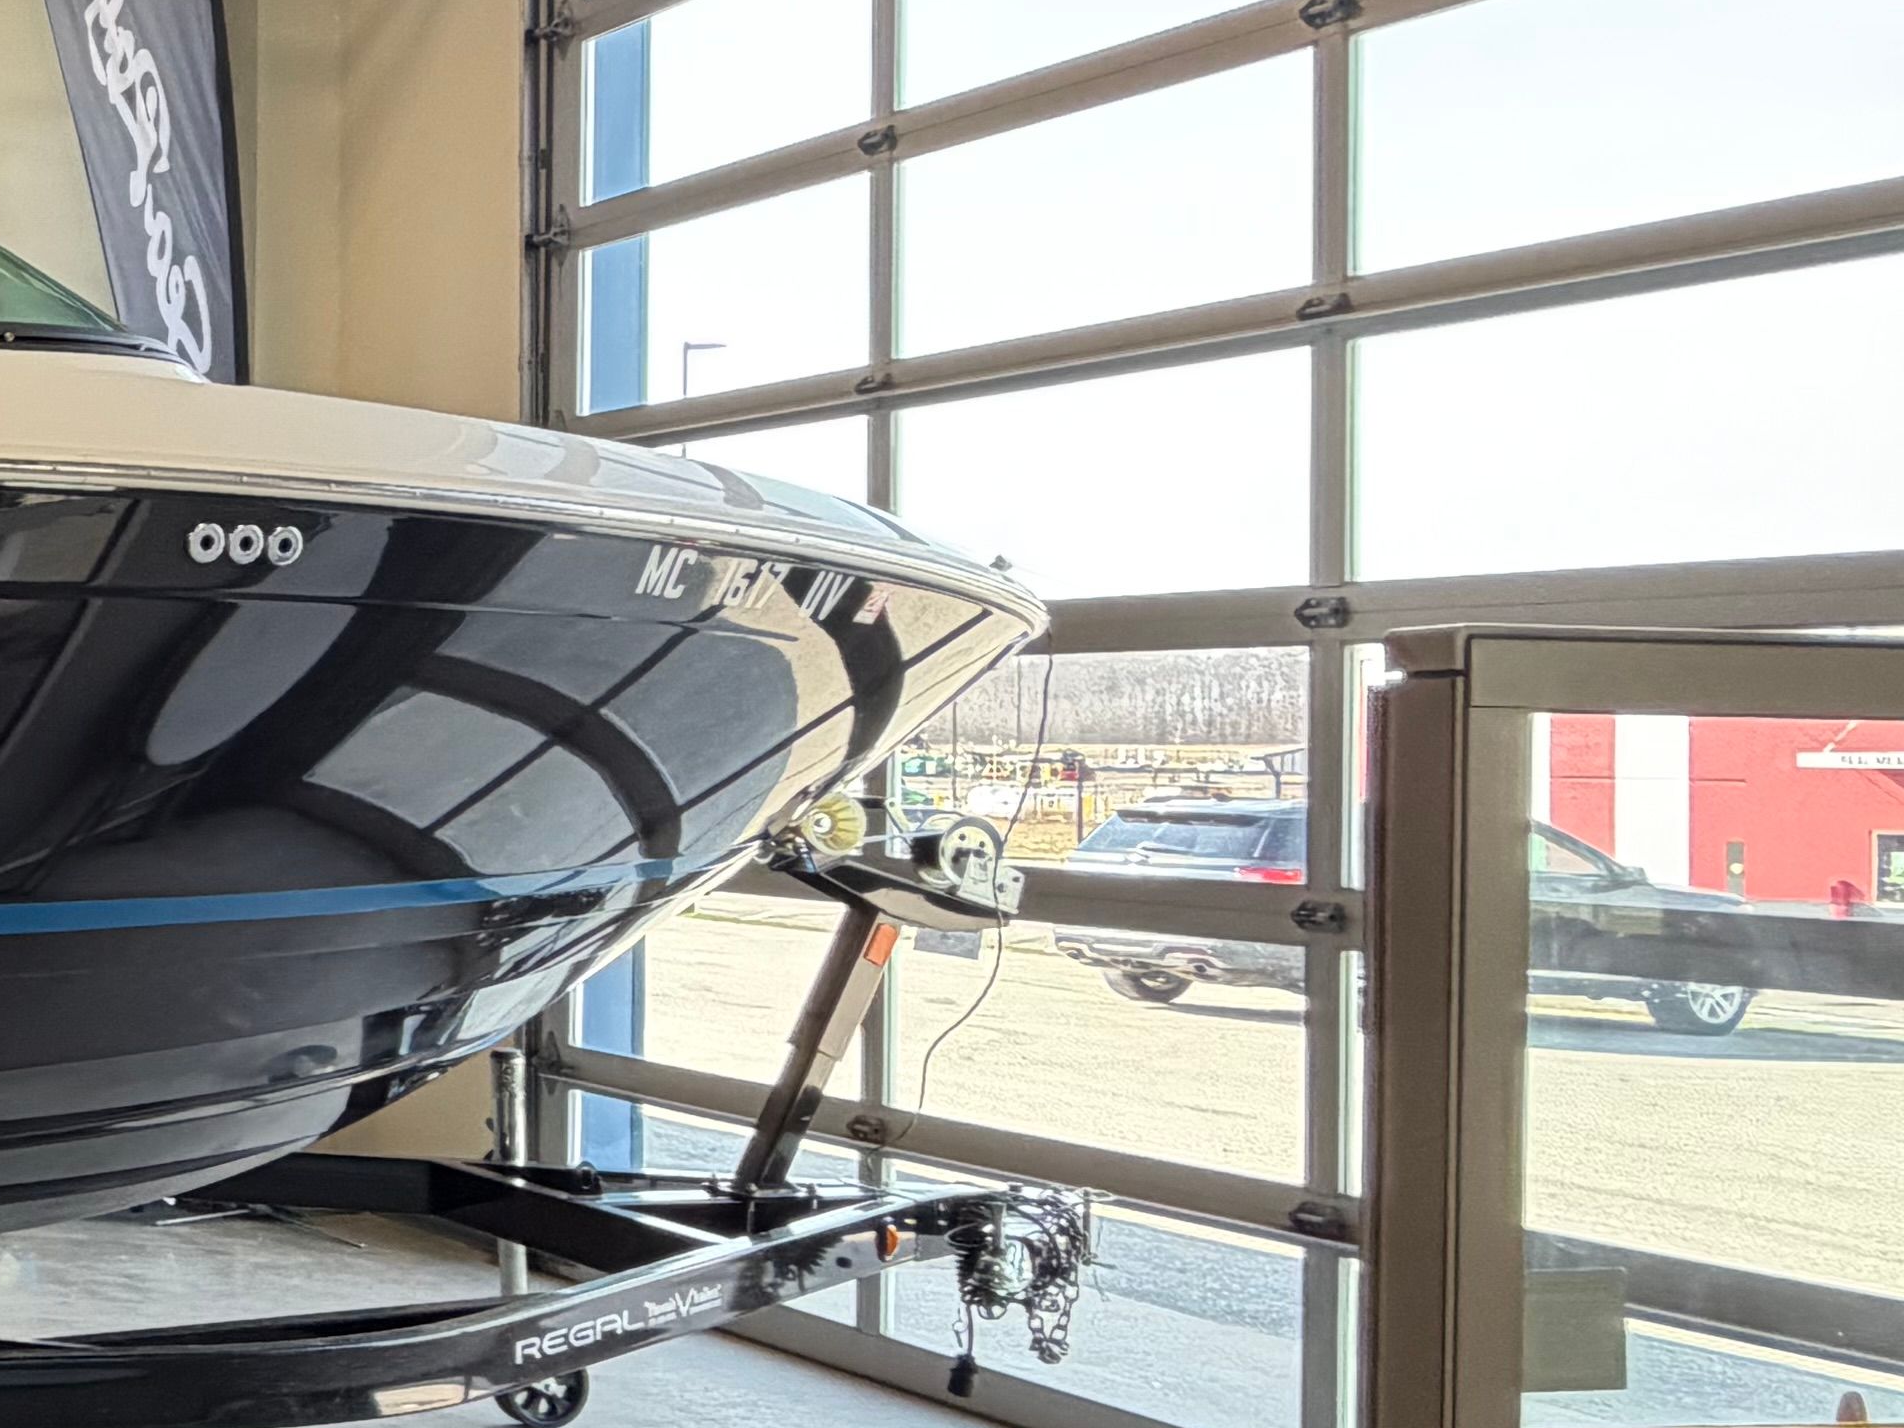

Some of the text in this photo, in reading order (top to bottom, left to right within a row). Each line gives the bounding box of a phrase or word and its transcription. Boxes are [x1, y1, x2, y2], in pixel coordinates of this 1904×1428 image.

[634, 544, 699, 600] MC
[712, 558, 792, 610] 1617
[800, 570, 856, 622] UV
[514, 1308, 646, 1366] REGAL
